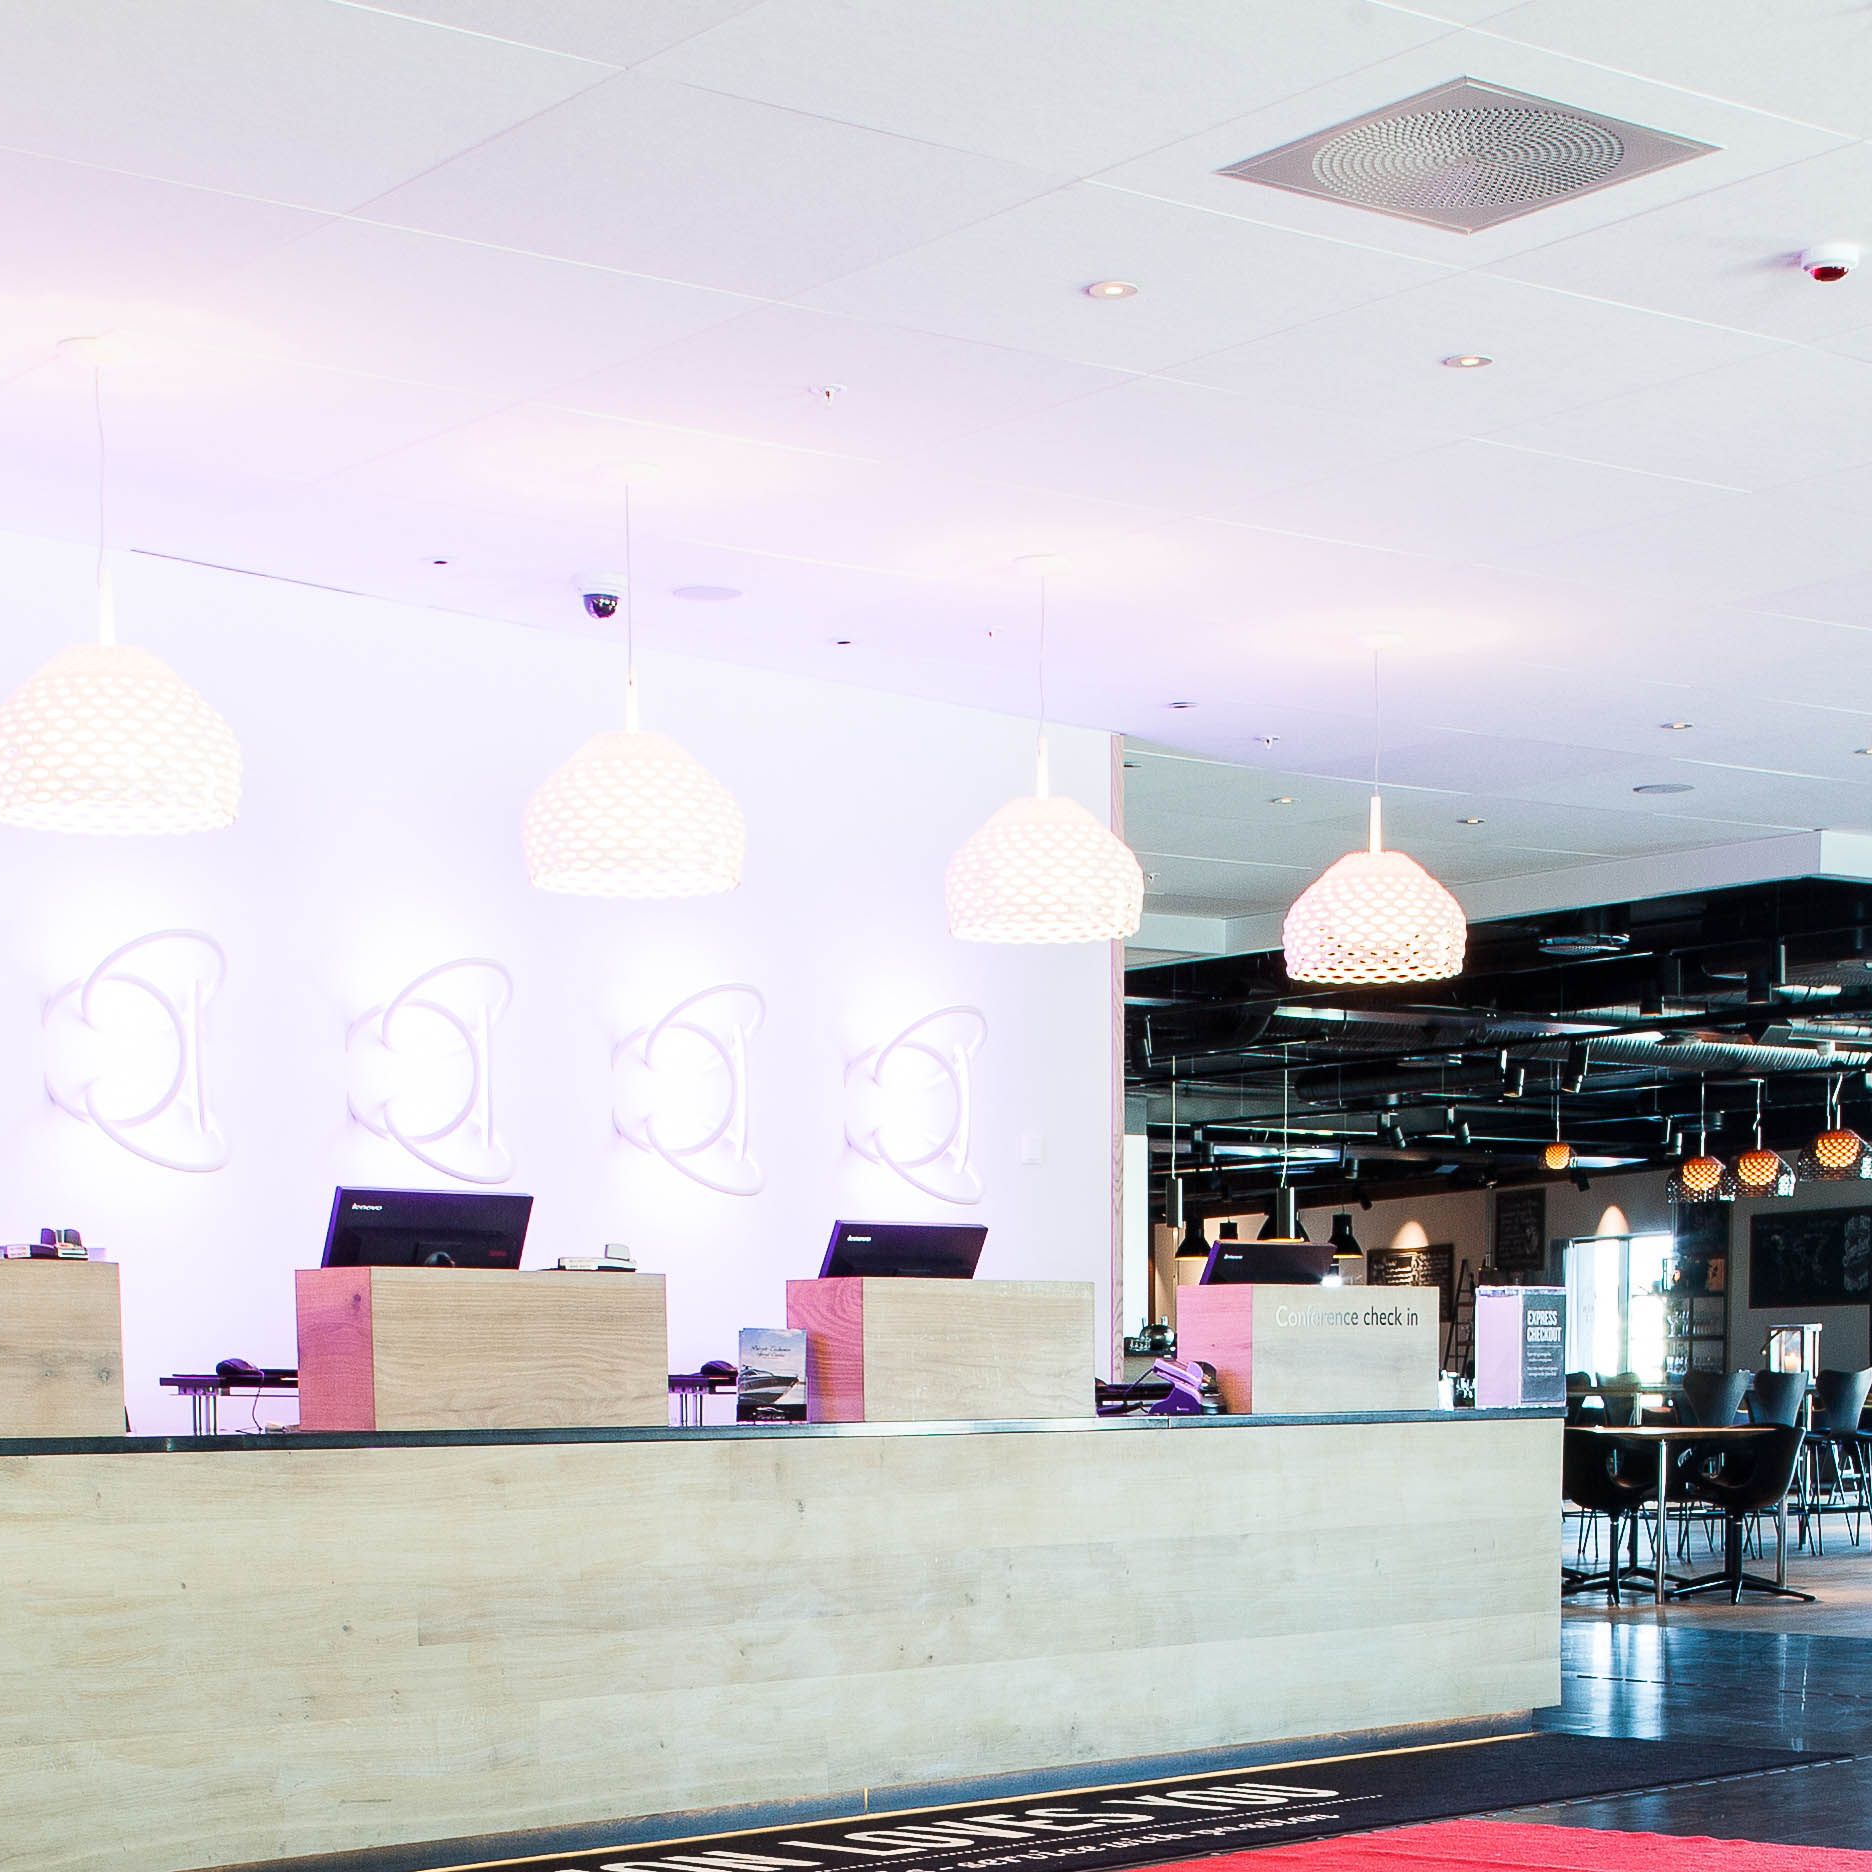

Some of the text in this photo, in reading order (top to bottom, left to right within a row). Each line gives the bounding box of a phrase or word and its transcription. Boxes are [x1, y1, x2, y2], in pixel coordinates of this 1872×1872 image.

[1275, 1305, 1419, 1328] Conference check in
[1527, 1310, 1558, 1326] EXPRESS
[1526, 1326, 1563, 1342] CHECKOUT
[778, 1808, 1155, 1857] LOVES
[1101, 1783, 1340, 1812] YOU
[956, 1845, 1105, 1869] service
[1104, 1832, 1194, 1849] with
